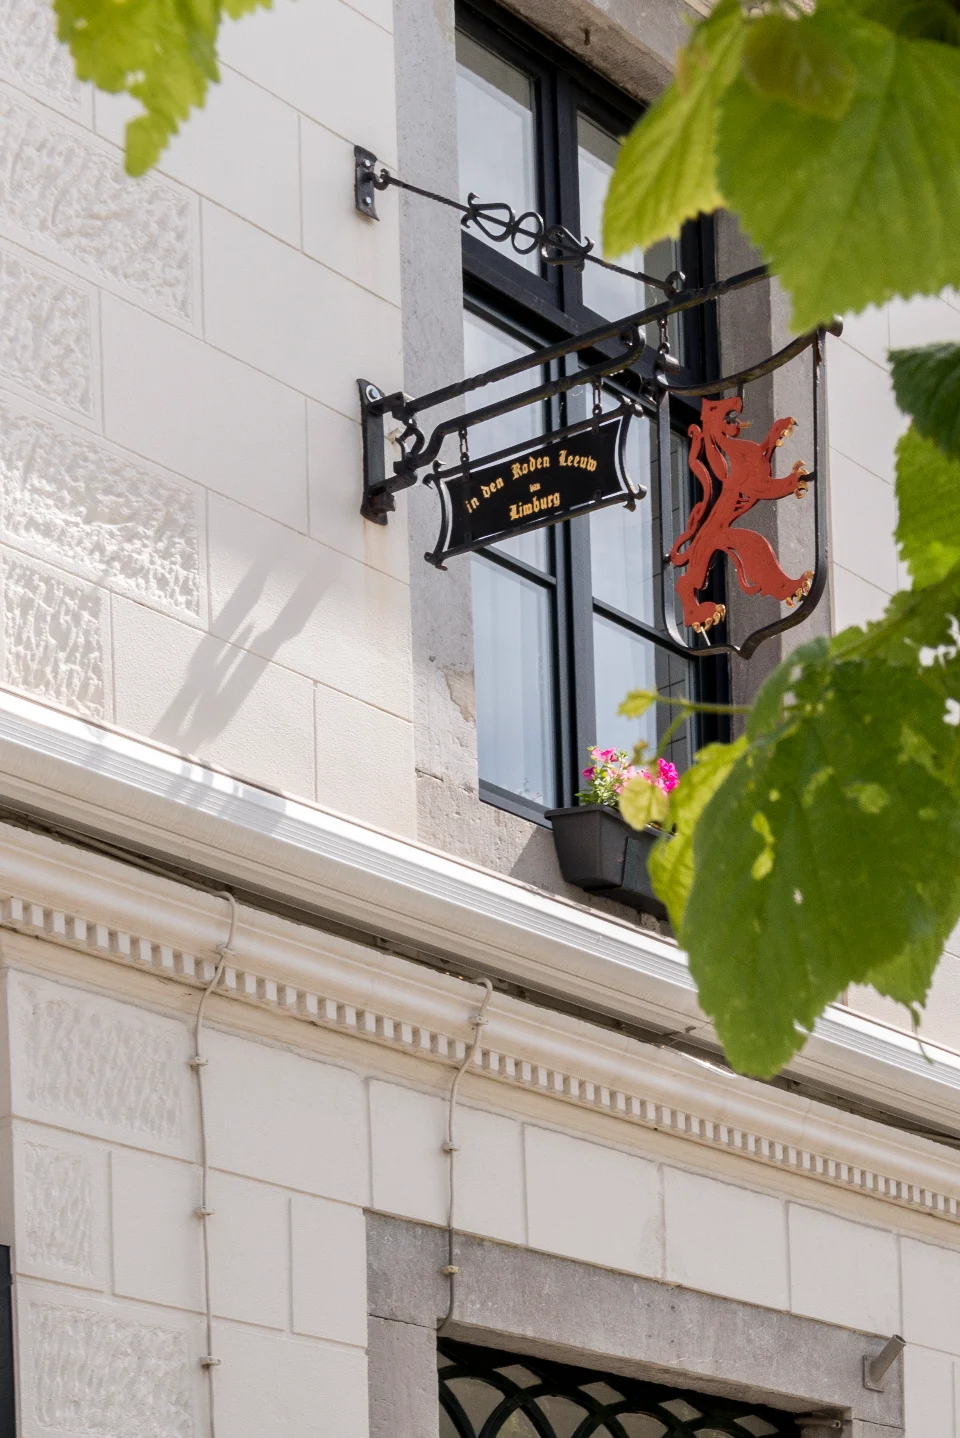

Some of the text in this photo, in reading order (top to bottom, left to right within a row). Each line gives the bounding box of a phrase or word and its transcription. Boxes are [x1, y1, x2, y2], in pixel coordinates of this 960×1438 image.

[465, 450, 597, 513] in den Roden Leeuw
[509, 492, 561, 521] Limburg
